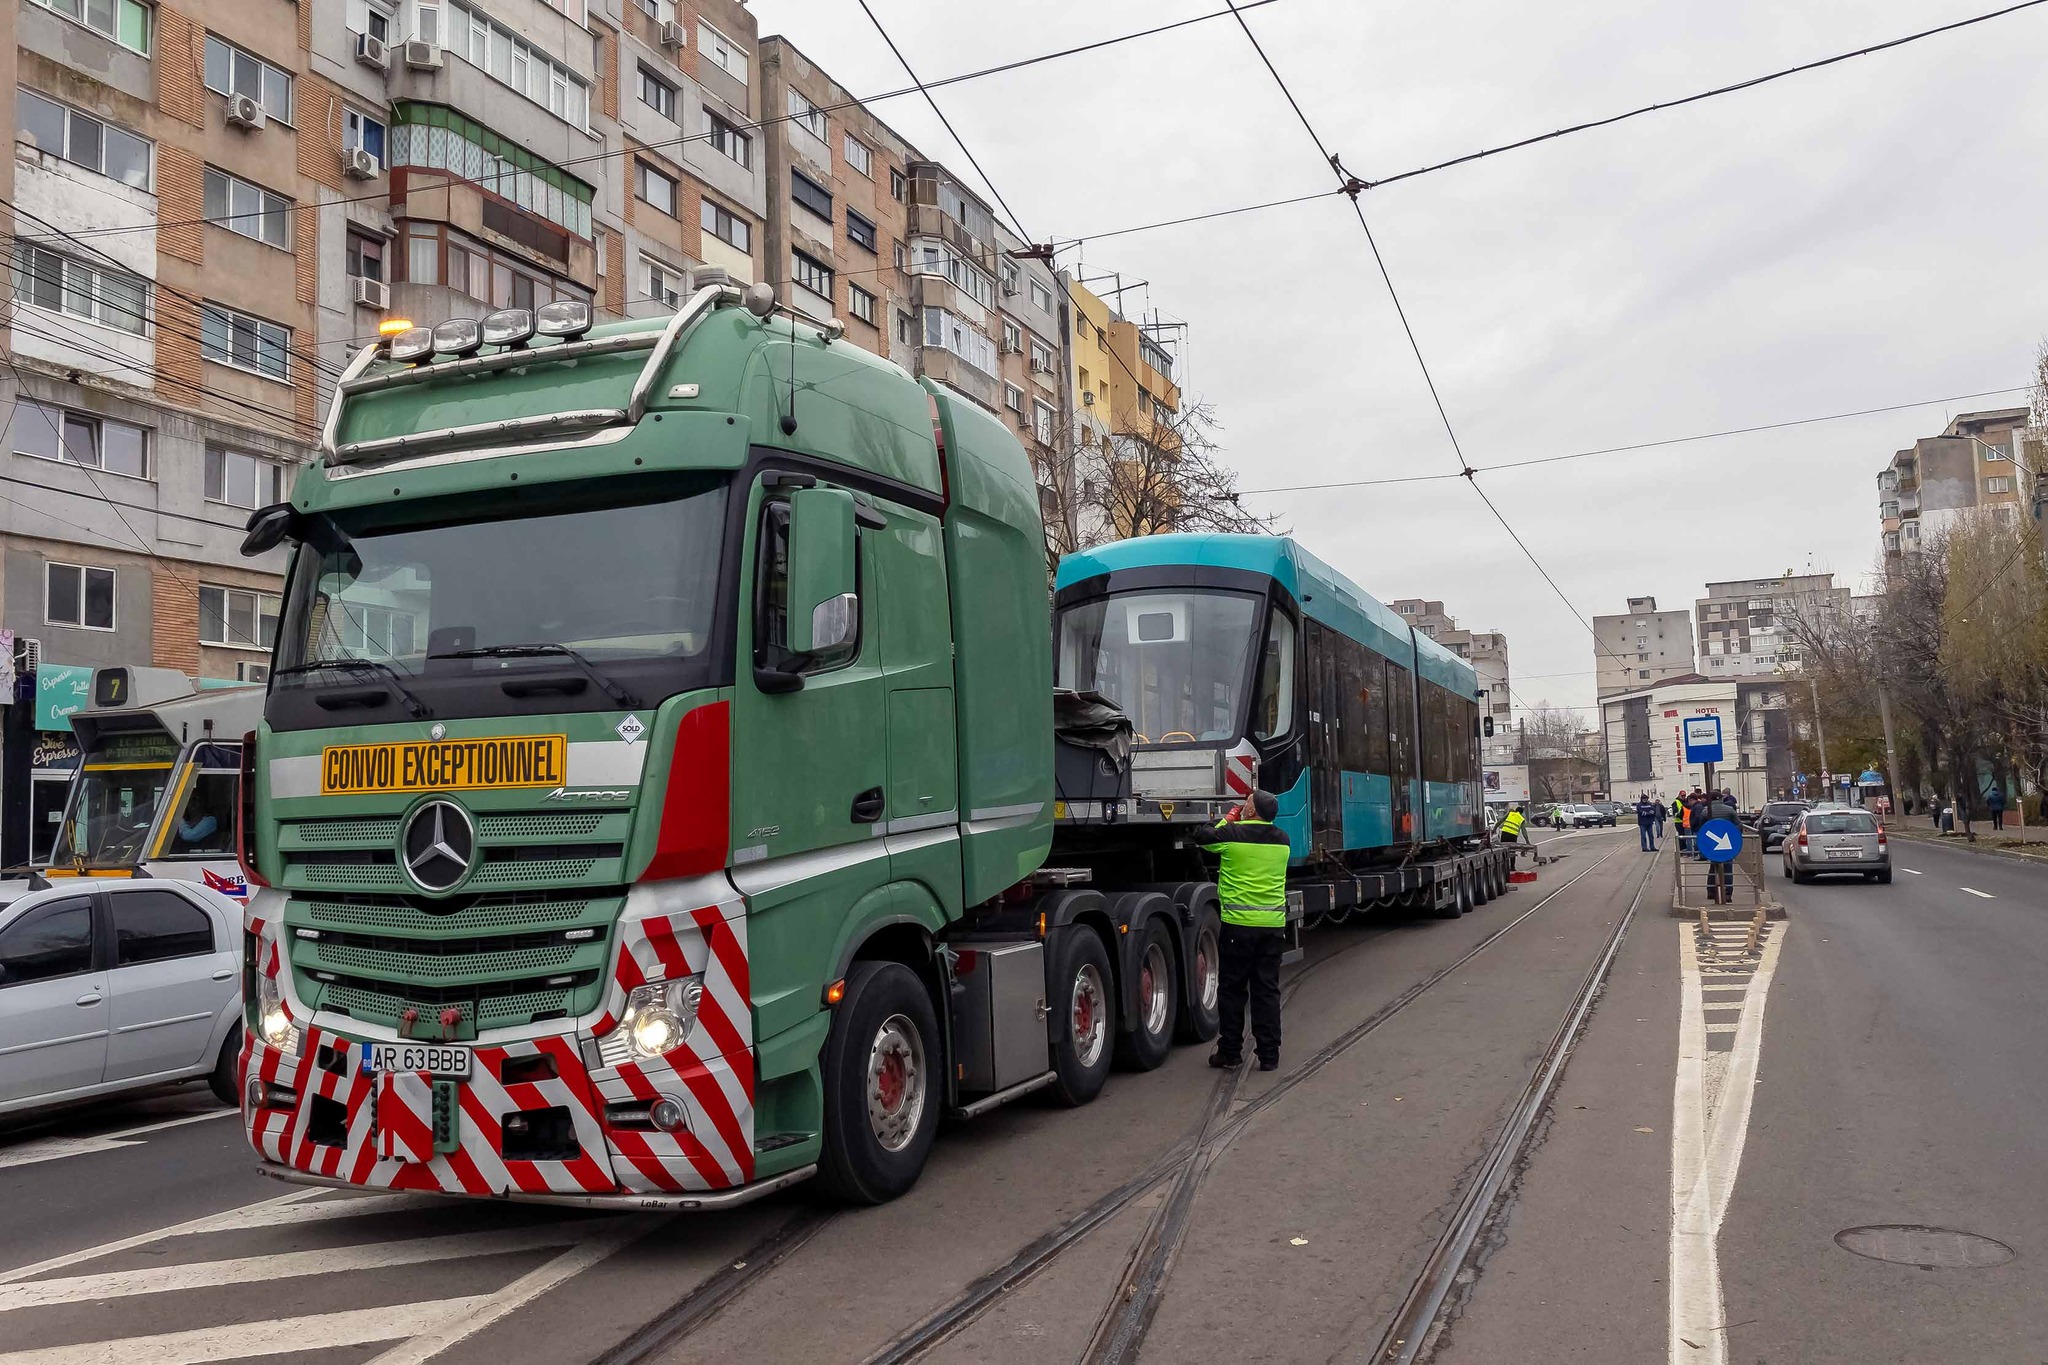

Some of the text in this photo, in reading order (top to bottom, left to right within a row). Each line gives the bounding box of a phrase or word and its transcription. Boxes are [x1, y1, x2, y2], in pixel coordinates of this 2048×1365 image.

[111, 678, 121, 699] 7
[32, 746, 80, 767] Espresso
[327, 740, 558, 790] CONVOI EXCEPTIONNEL
[373, 1047, 397, 1069] AR
[640, 1199, 668, 1208] LoBar
